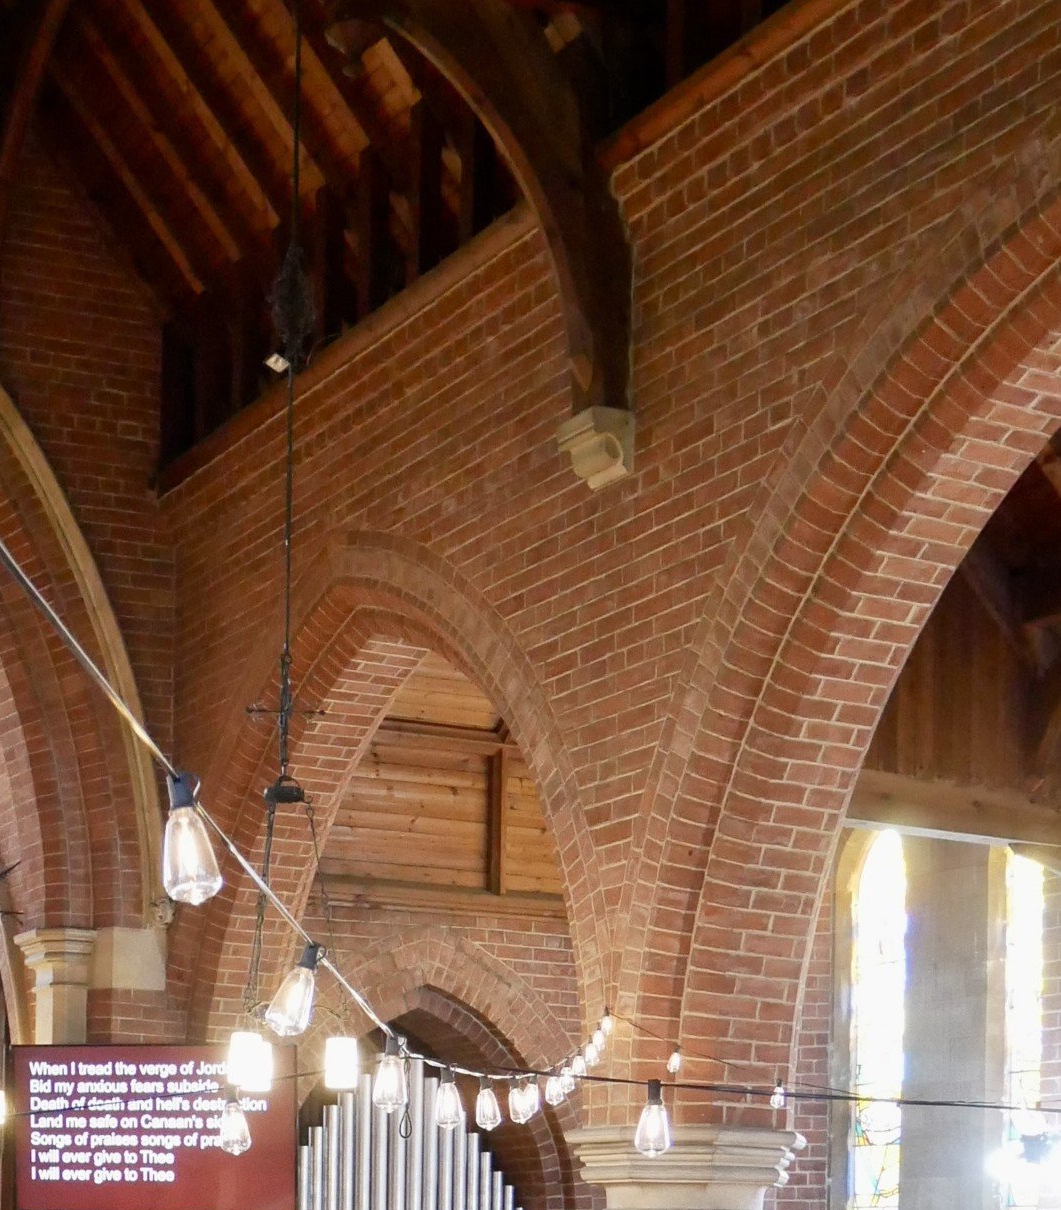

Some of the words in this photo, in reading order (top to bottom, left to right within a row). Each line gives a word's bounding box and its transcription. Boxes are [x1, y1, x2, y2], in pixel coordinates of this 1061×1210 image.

[29, 1061, 68, 1076] When
[70, 1061, 76, 1076] I
[78, 1061, 113, 1076] tread
[115, 1061, 137, 1076] the
[139, 1064, 178, 1079] verge
[180, 1060, 195, 1075] of
[30, 1079, 52, 1093] Bid
[54, 1081, 75, 1096] my
[77, 1079, 128, 1093] anxious
[130, 1079, 165, 1093] fears
[167, 1079, 219, 1093] subside
[30, 1096, 70, 1111] Death
[72, 1096, 87, 1111] of
[87, 1096, 126, 1111] death
[127, 1097, 154, 1111] and
[156, 1096, 191, 1111] hell's
[193, 1096, 268, 1111] destrtion
[31, 1114, 64, 1129] Land
[66, 1117, 88, 1129] me
[89, 1114, 119, 1129] safe
[120, 1117, 139, 1129] on
[141, 1114, 204, 1129] Canaan's
[31, 1131, 73, 1149] Songs
[74, 1131, 89, 1146] of
[91, 1132, 139, 1149] praises
[141, 1134, 182, 1149] songs
[184, 1132, 199, 1147] of
[31, 1149, 36, 1163] I
[38, 1149, 60, 1163] will
[62, 1151, 93, 1164] ever
[94, 1149, 123, 1167] give
[124, 1149, 139, 1164] to
[140, 1149, 175, 1164] Thee
[31, 1166, 37, 1181] I
[38, 1166, 60, 1181] will
[62, 1169, 93, 1181] ever
[94, 1166, 123, 1185] give
[124, 1167, 139, 1181] to
[140, 1167, 175, 1182] Thee
